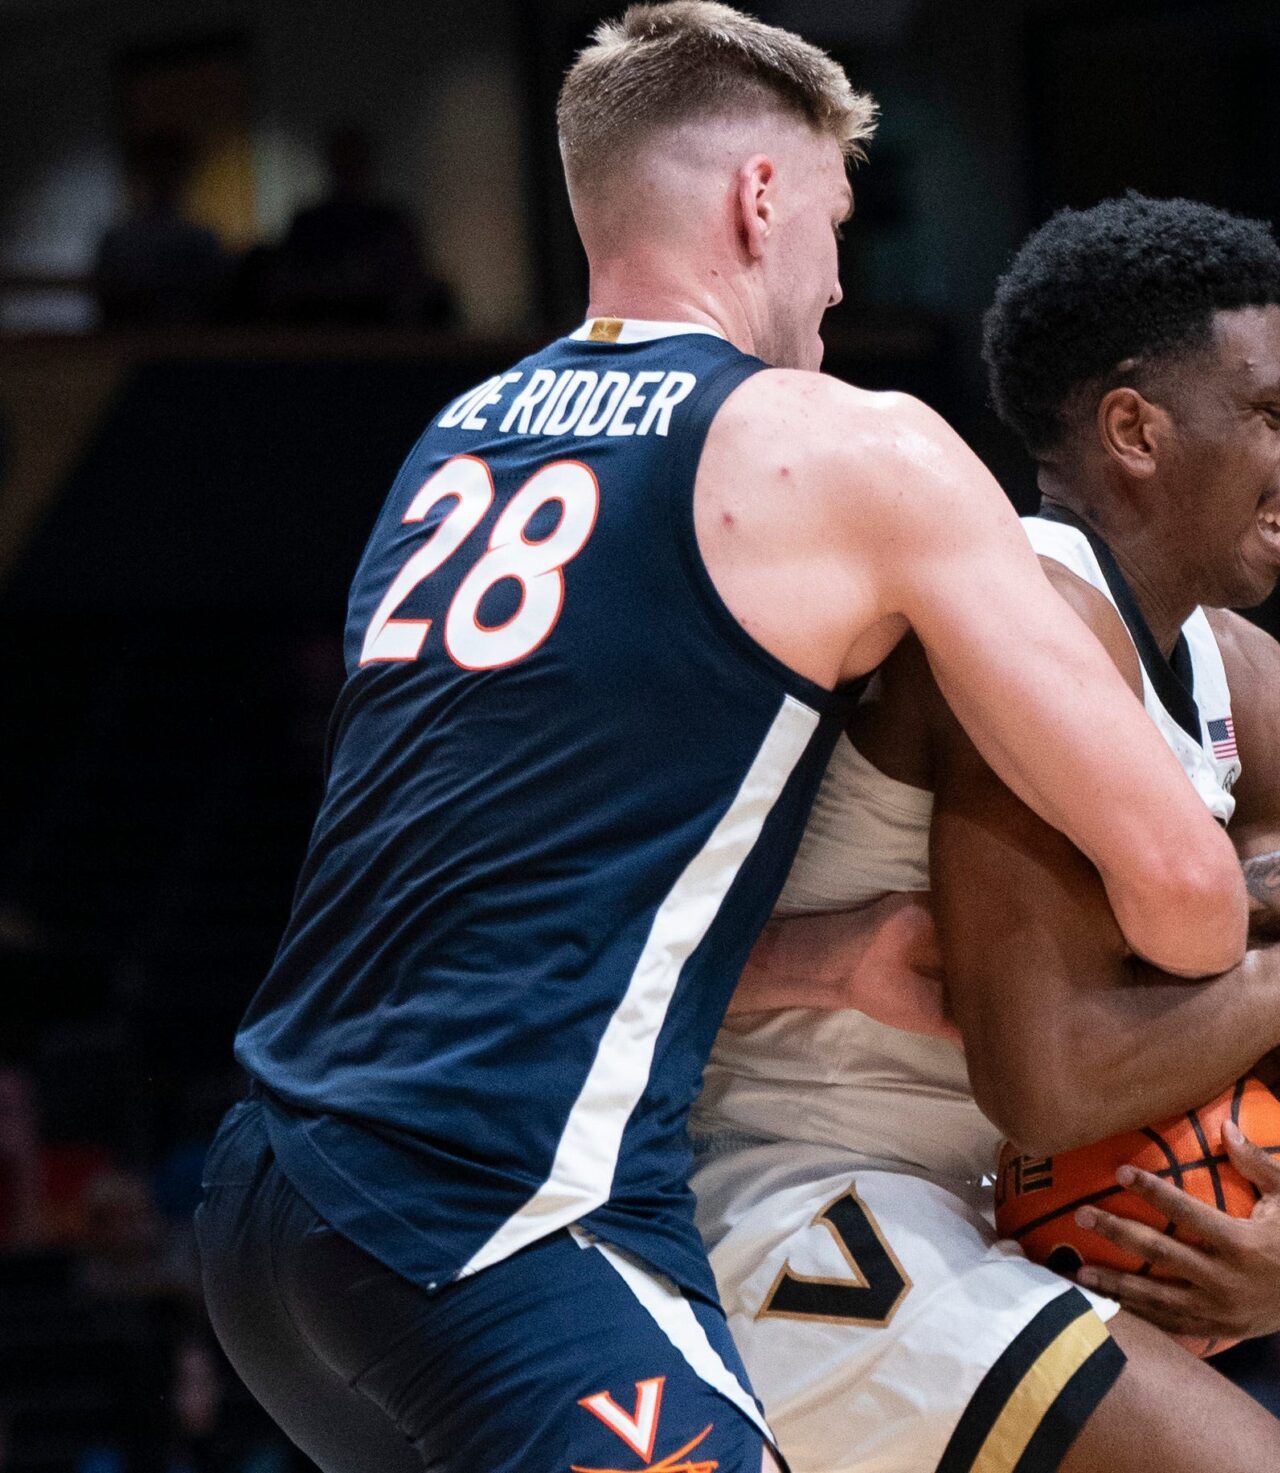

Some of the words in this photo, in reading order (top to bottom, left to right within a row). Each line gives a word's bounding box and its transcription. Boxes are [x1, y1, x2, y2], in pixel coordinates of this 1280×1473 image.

[438, 372, 523, 431] DE
[499, 368, 697, 437] RIDDER
[359, 454, 600, 671] 28
[577, 1375, 666, 1464] V
